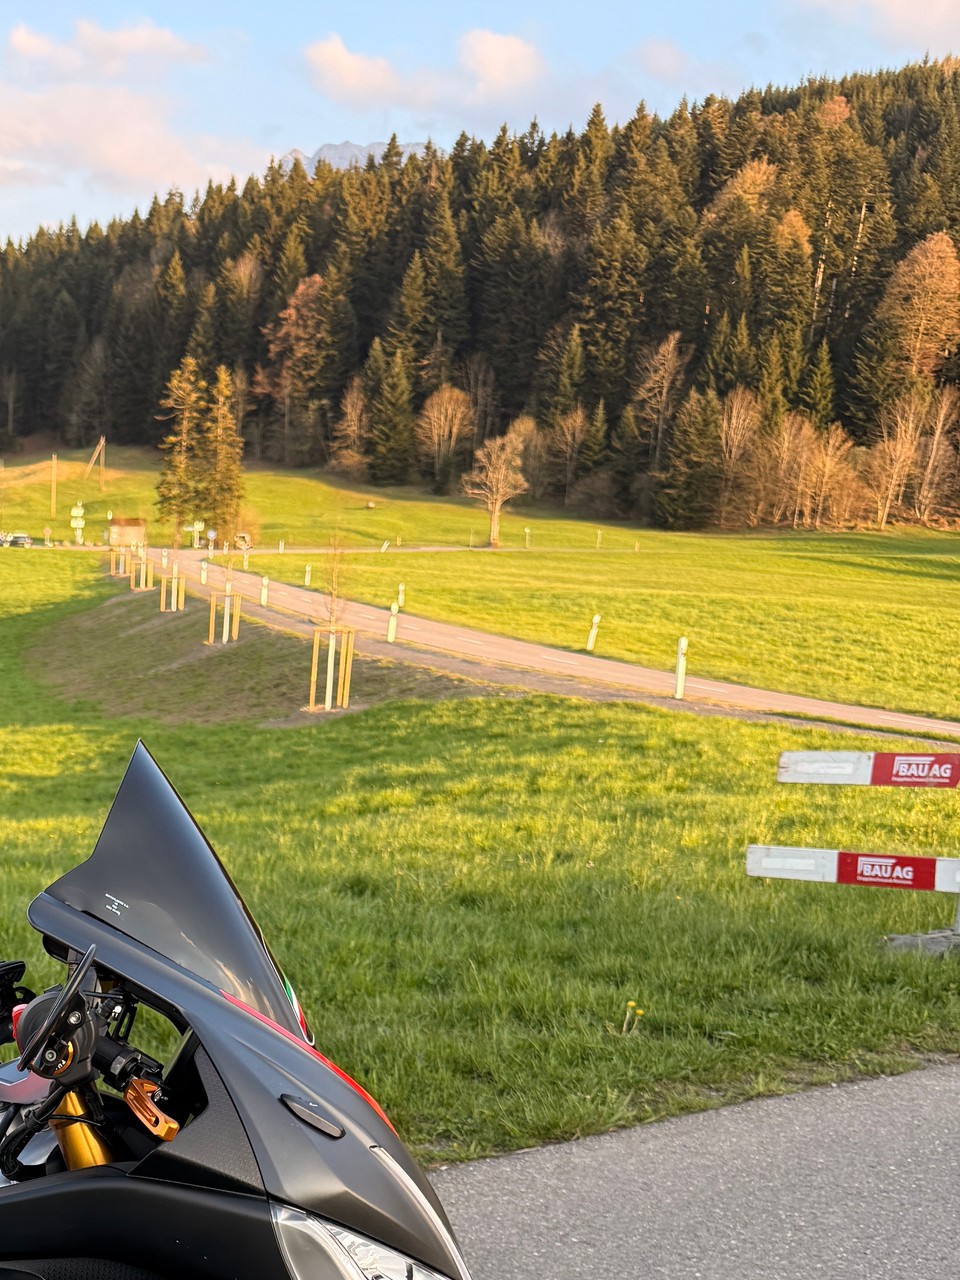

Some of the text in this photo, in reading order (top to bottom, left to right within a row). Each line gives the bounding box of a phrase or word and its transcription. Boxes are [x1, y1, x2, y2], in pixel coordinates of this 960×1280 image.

[898, 763, 952, 778] BAU AG
[863, 864, 913, 880] BAU AG
